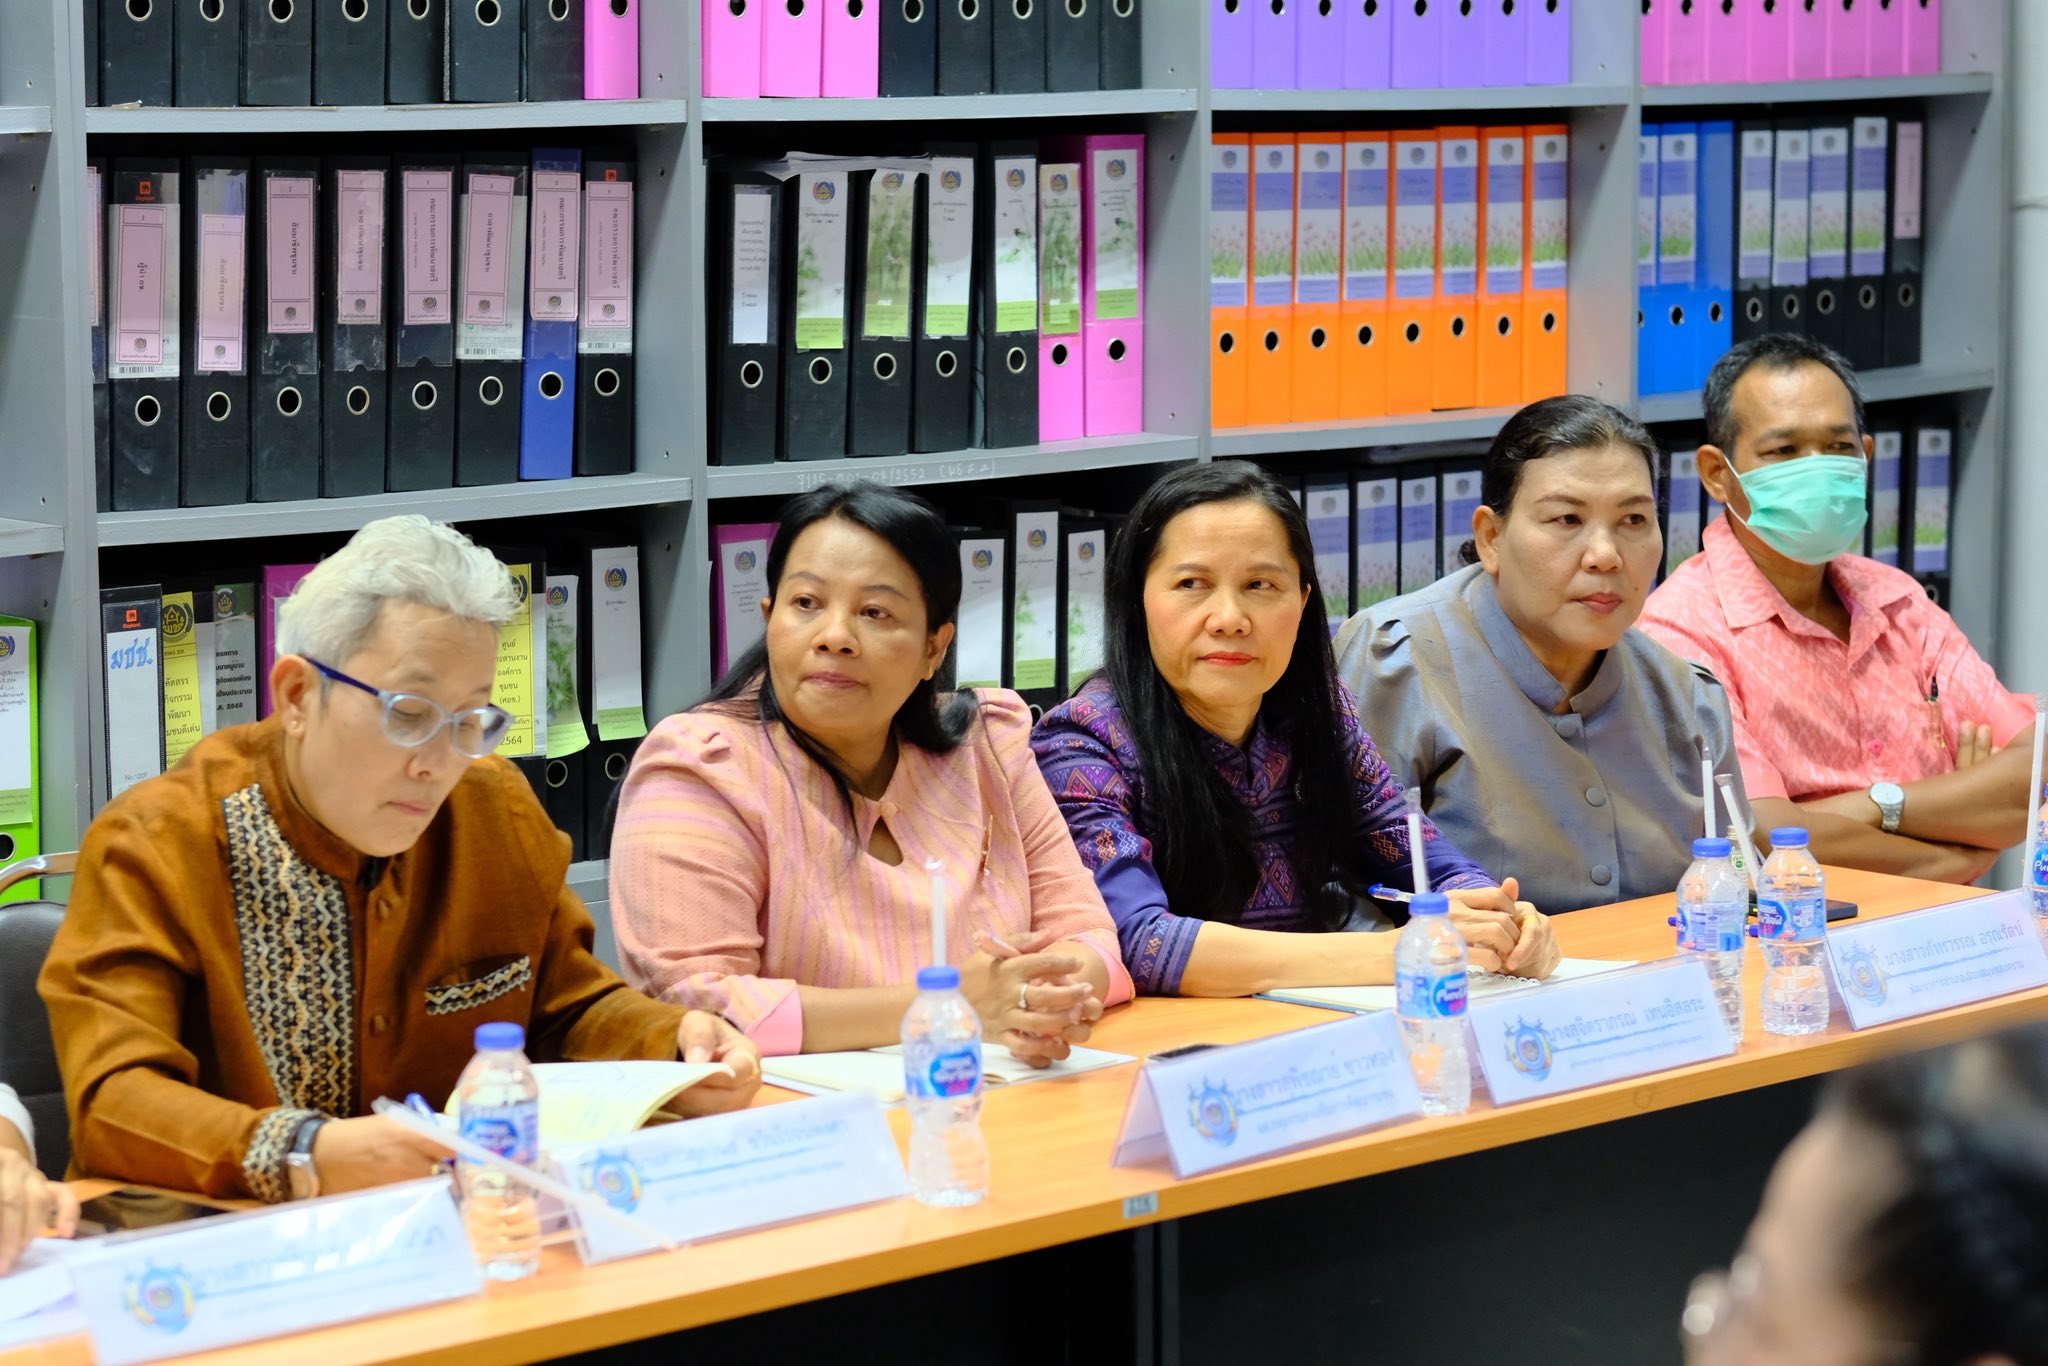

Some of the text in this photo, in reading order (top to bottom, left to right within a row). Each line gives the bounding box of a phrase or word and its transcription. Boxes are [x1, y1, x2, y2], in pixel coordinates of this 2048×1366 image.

[216, 649, 239, 657] ครงการ
[167, 709, 191, 720] พัฒนา
[166, 722, 201, 737] มชนดีเด่น
[500, 735, 522, 746] 2564
